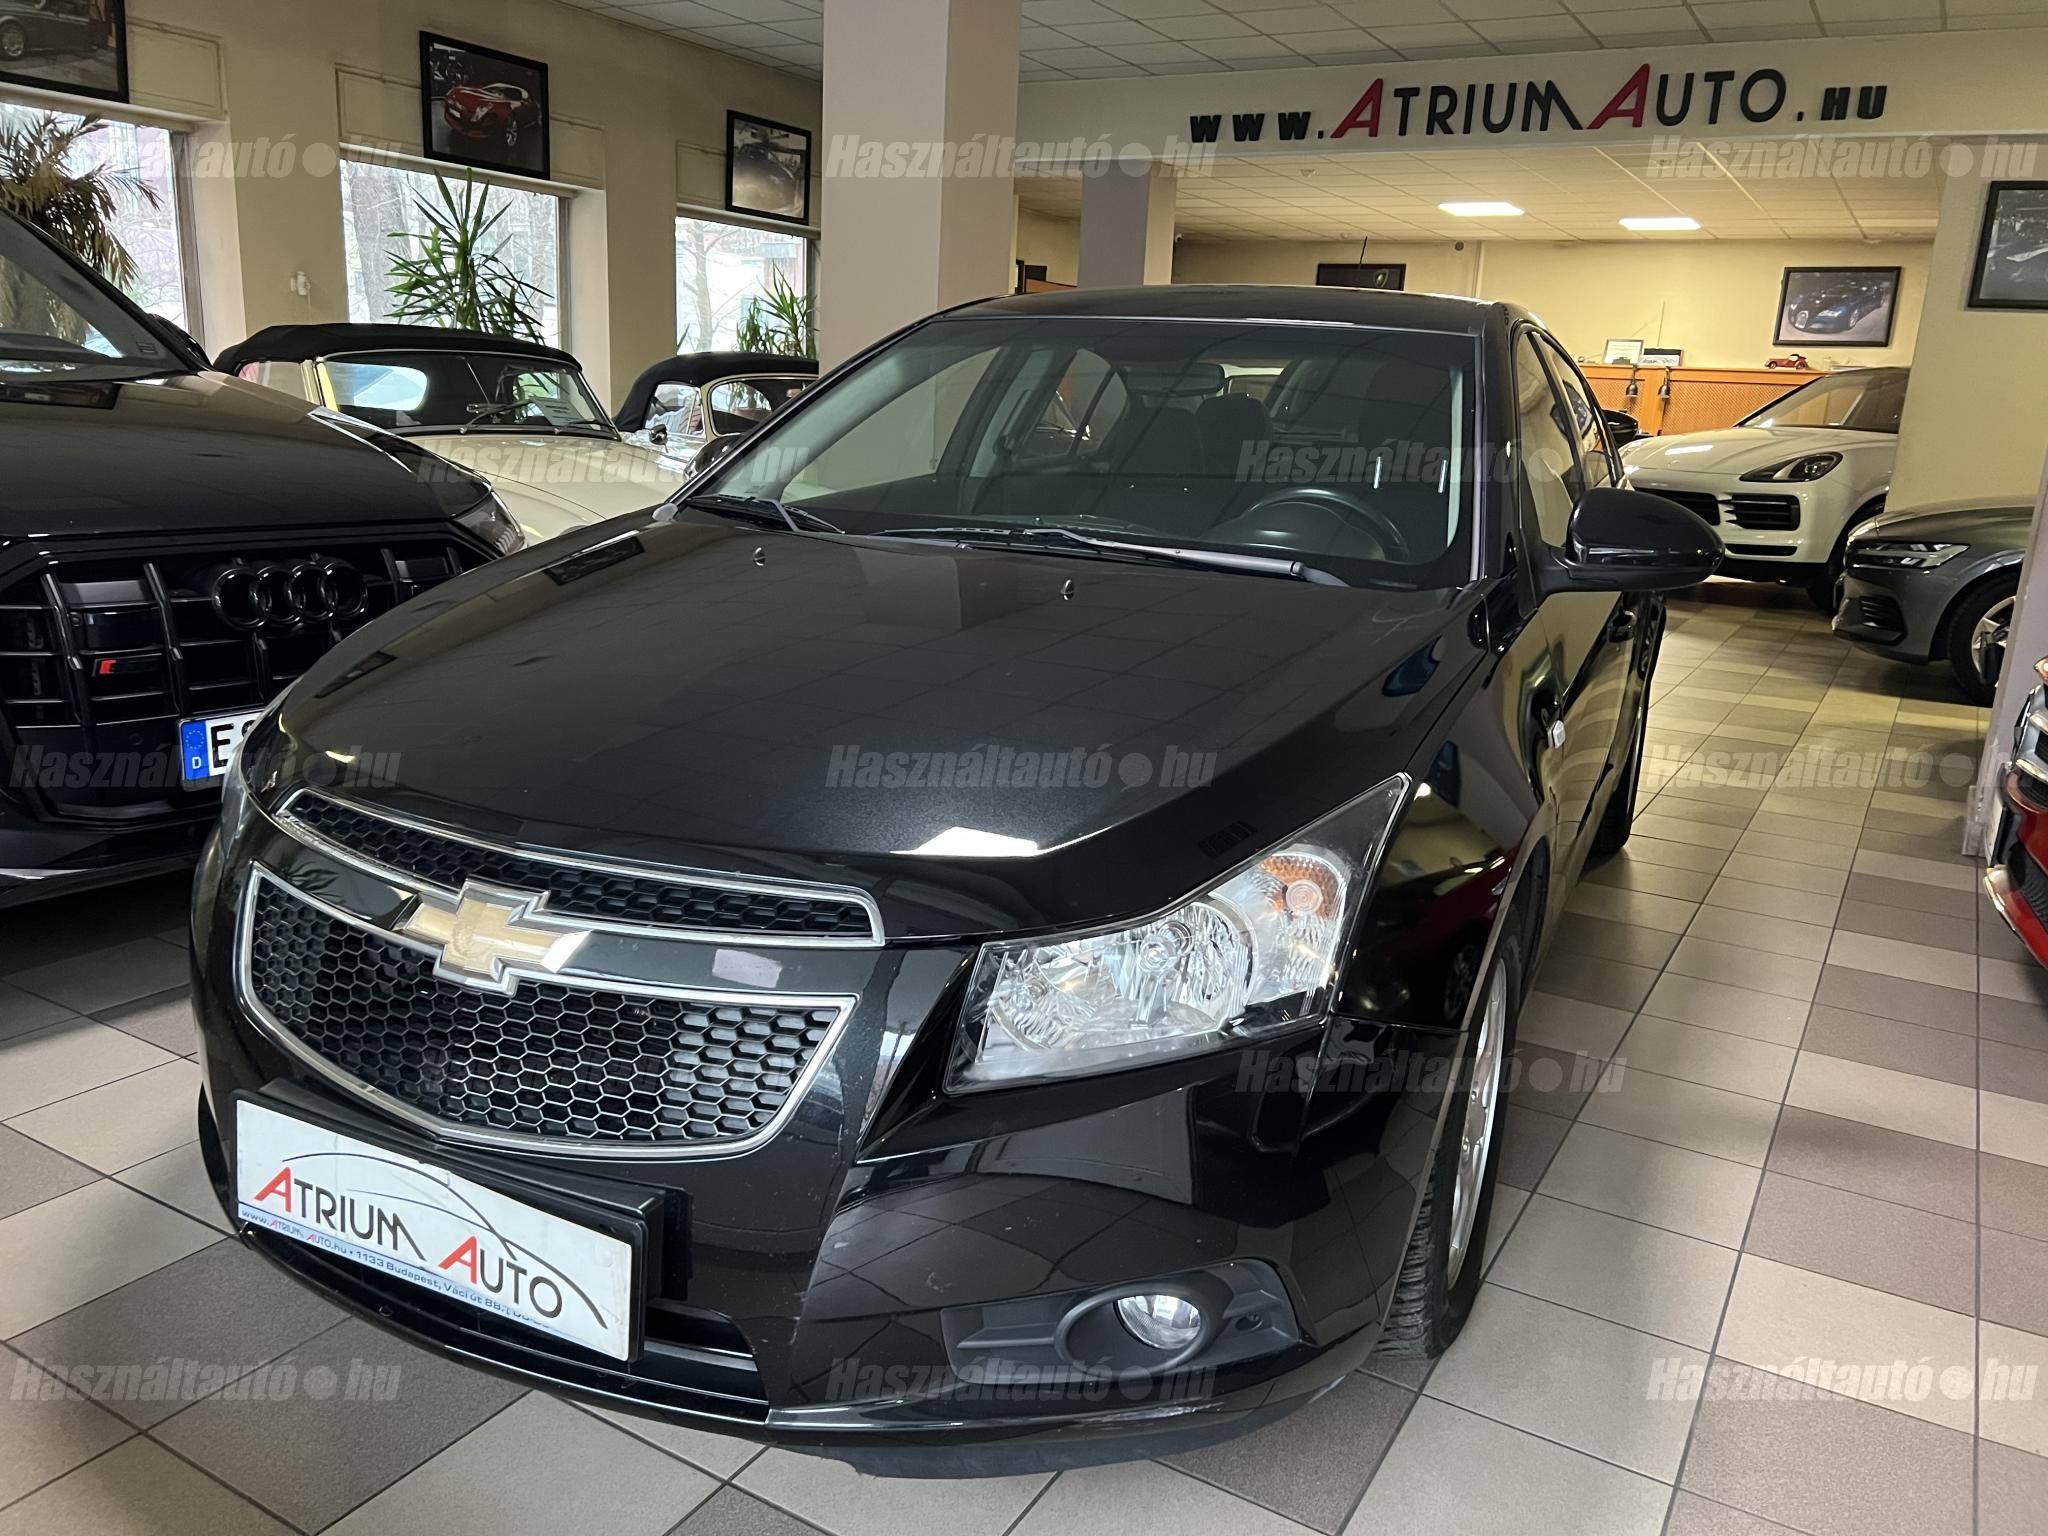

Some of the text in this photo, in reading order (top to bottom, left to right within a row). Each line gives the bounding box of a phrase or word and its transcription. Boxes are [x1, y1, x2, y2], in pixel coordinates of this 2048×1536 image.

[210, 719, 257, 770] E
[191, 756, 202, 769] D
[254, 1166, 563, 1319] ATRIUM AUTO
[356, 1250, 384, 1267] 1133
